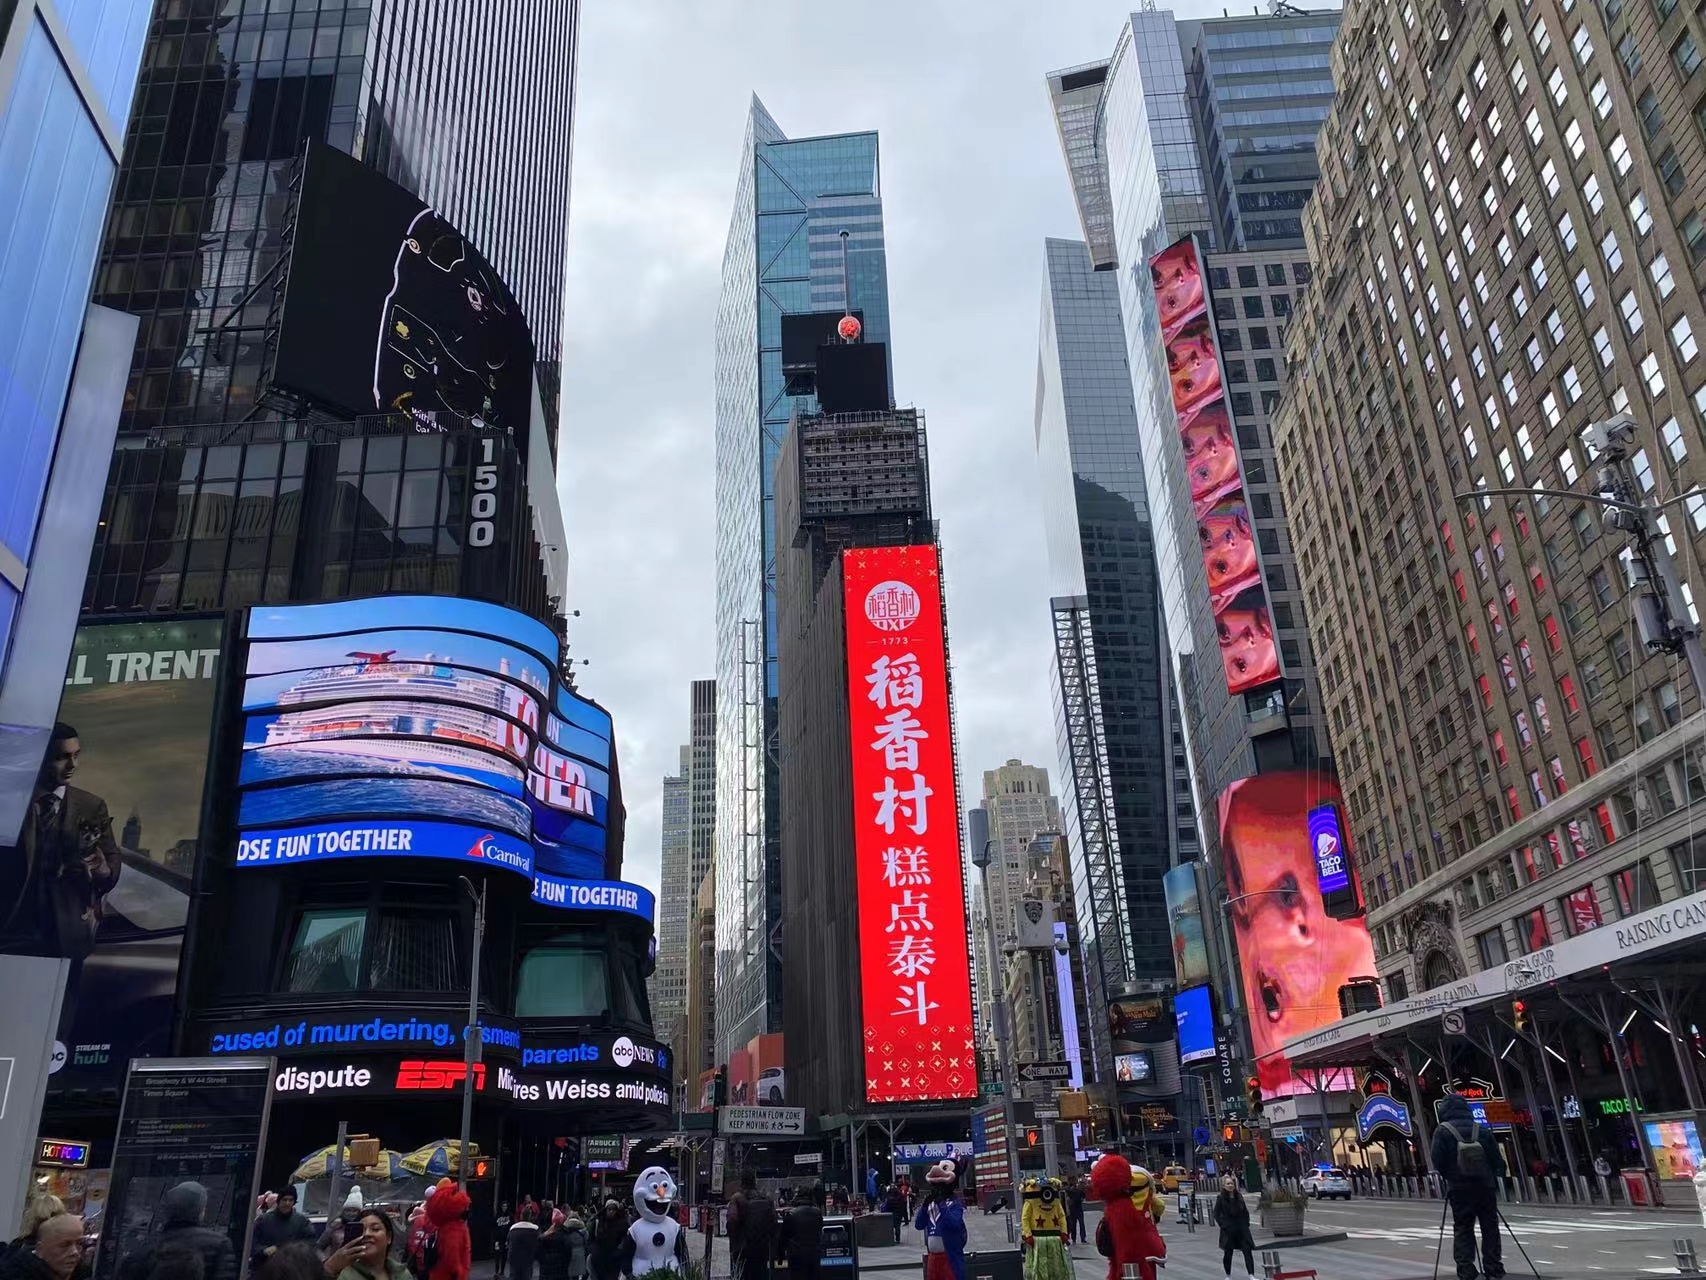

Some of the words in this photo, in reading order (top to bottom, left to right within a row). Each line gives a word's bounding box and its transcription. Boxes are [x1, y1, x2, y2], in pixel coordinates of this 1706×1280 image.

[468, 438, 498, 547] 1500
[868, 587, 915, 618] 稻香村
[881, 636, 909, 646] 1773
[106, 648, 220, 683] TRENT
[276, 836, 308, 857] FUN
[317, 828, 412, 851] TOGETHER
[486, 843, 531, 872] Carnival
[1318, 855, 1341, 869] TACO
[1321, 864, 1343, 877] BELL
[541, 879, 566, 903] FUN
[570, 885, 638, 910] TOGETHER
[1616, 913, 1672, 949] RAISING
[1442, 983, 1480, 1002] CANTINA
[284, 1022, 306, 1046] of
[311, 1017, 454, 1046] murdering,
[75, 1044, 101, 1052] STREAM
[522, 1043, 599, 1067] parents
[633, 1044, 655, 1064] NEWS
[1199, 1049, 1214, 1057] CHASE
[74, 1052, 109, 1065] hulu
[1218, 1036, 1232, 1084] SQUARE
[275, 1065, 371, 1094] dispute
[395, 1061, 485, 1090] ESPN
[1025, 1068, 1041, 1076] ONE
[1048, 1066, 1065, 1075] WAY
[546, 1079, 610, 1100] Weiss
[615, 1081, 644, 1101] amid
[729, 1110, 767, 1119] PEDESTRIAN
[768, 1111, 784, 1119] FLOW
[785, 1112, 801, 1120] ZONE
[1600, 1100, 1624, 1114] TACO
[729, 1120, 744, 1129] KEEP
[746, 1121, 769, 1130] MOVING
[43, 1145, 62, 1157] HOT
